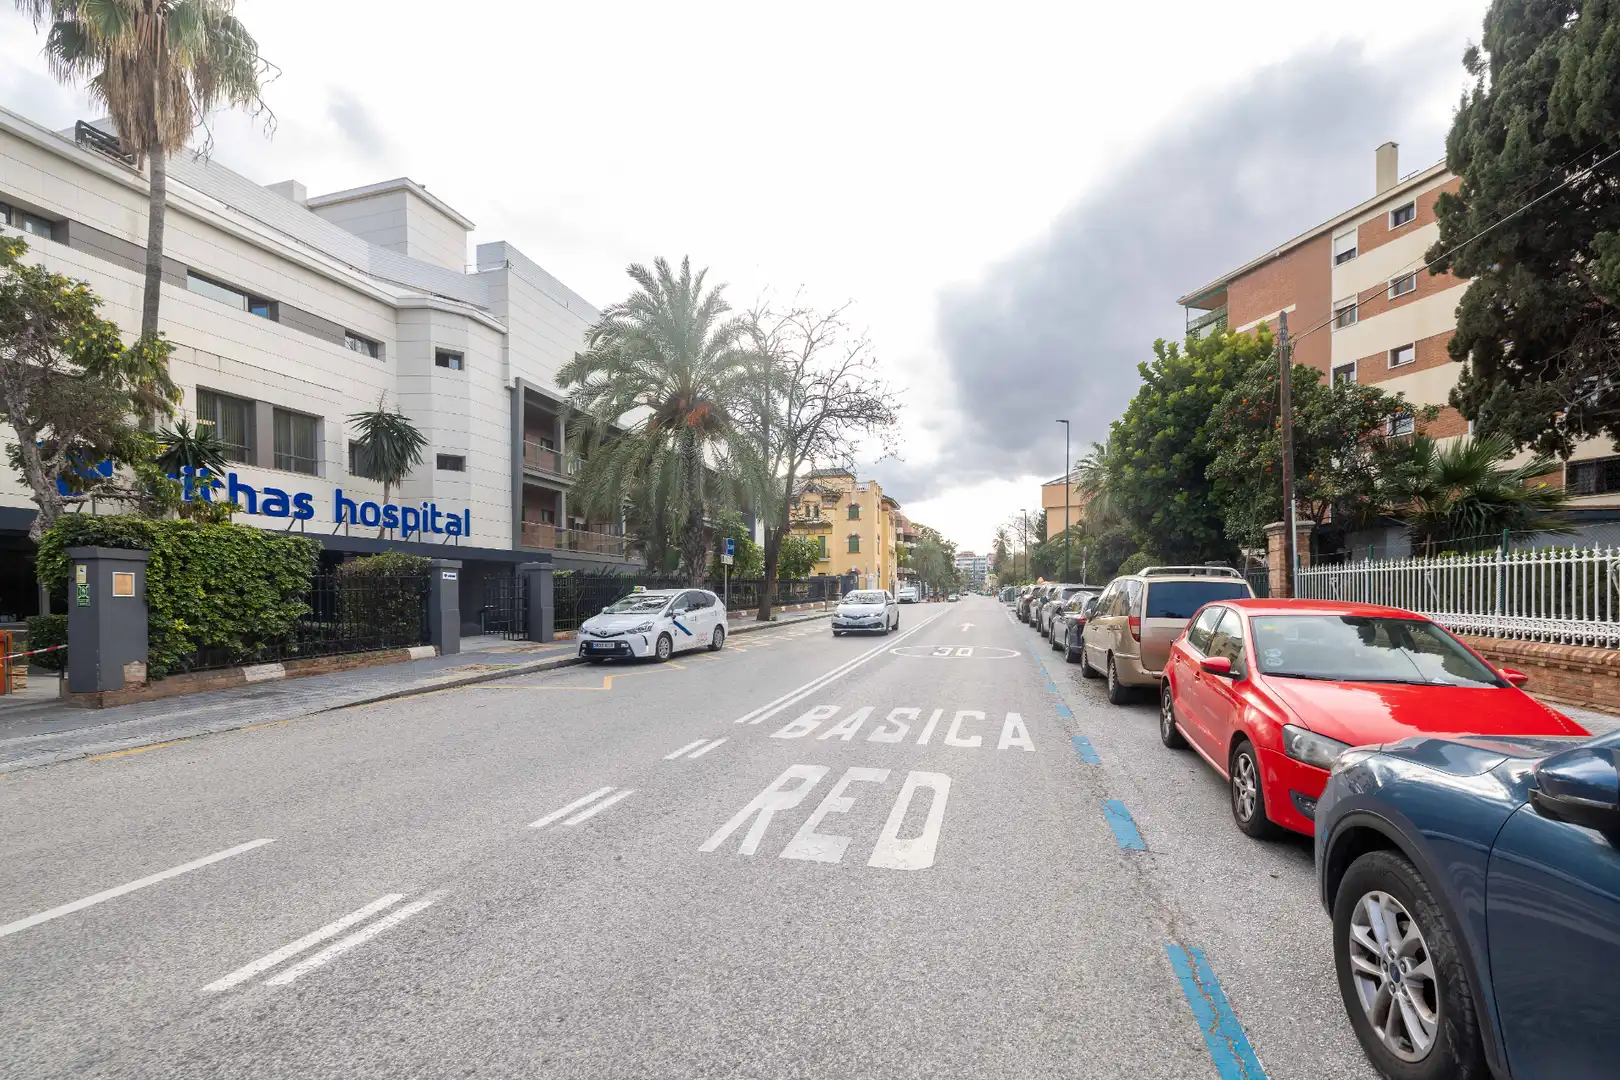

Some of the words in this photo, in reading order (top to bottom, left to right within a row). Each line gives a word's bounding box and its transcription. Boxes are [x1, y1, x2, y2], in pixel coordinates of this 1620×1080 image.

[165, 466, 314, 520] ithas
[333, 488, 471, 538] hospital
[932, 647, 974, 657] 30
[769, 705, 1036, 751] BASICA
[698, 764, 952, 871] RED
